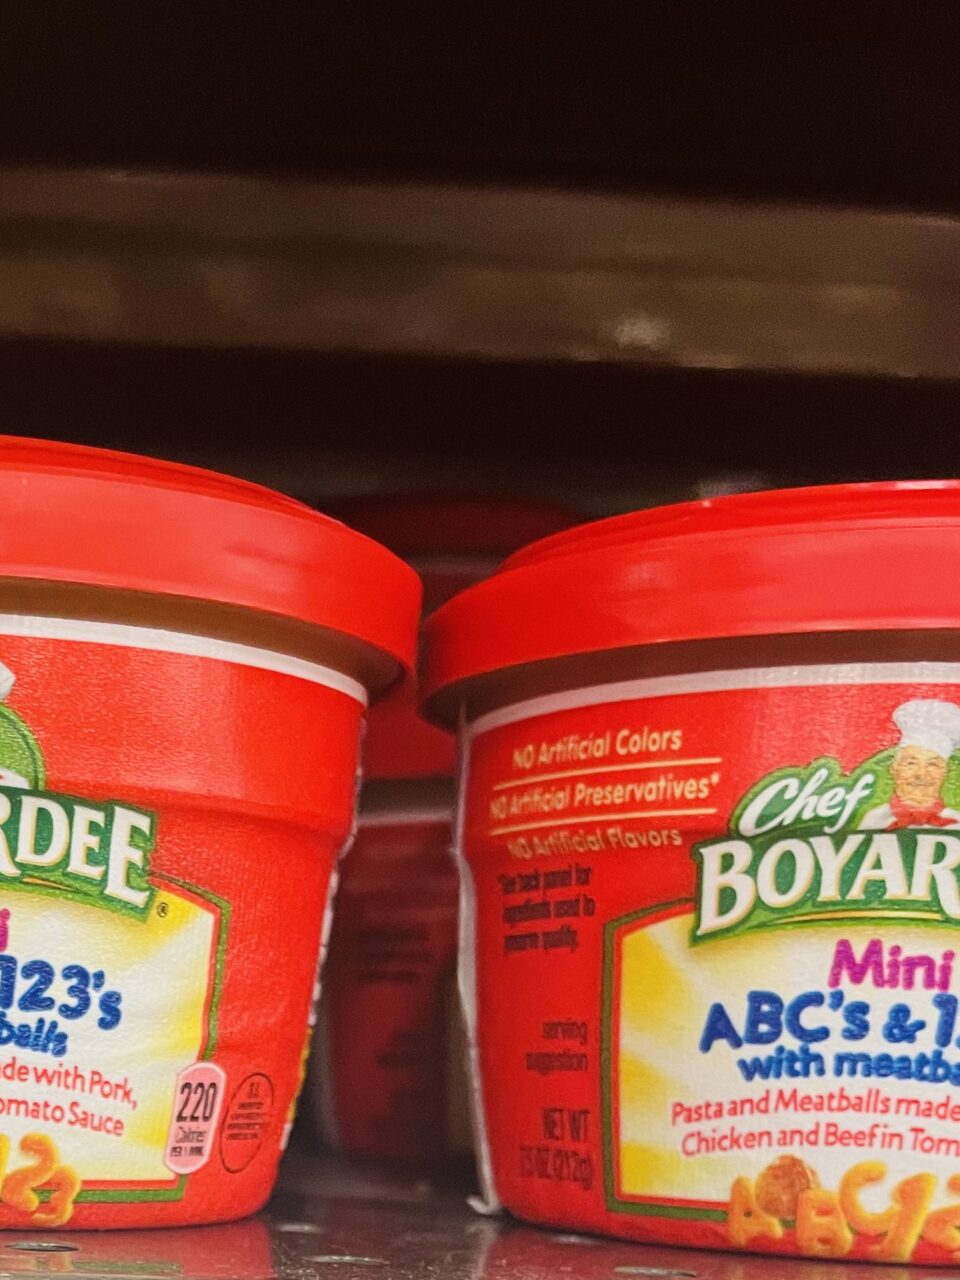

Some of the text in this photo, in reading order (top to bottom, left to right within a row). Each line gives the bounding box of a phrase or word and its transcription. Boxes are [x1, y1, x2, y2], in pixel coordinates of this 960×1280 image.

[513, 726, 682, 769] NO Artificial Colors
[510, 785, 569, 815] Artificial
[739, 768, 873, 836] Chef
[533, 829, 604, 856] Artificial
[607, 826, 682, 850] Flavors
[828, 938, 955, 991] Mini
[698, 990, 871, 1054] ABC's
[883, 1003, 926, 1044] &
[736, 1044, 825, 1082] with
[32, 1060, 86, 1091] with
[90, 1071, 137, 1110] Pork,
[176, 1081, 217, 1122] 220
[68, 1101, 125, 1138] Sauce
[671, 1087, 960, 1127] Pasta and Meatballs made
[681, 1125, 773, 1157] Chicken
[777, 1122, 820, 1146] and
[824, 1123, 877, 1148] Beef
[879, 1125, 903, 1149] in
